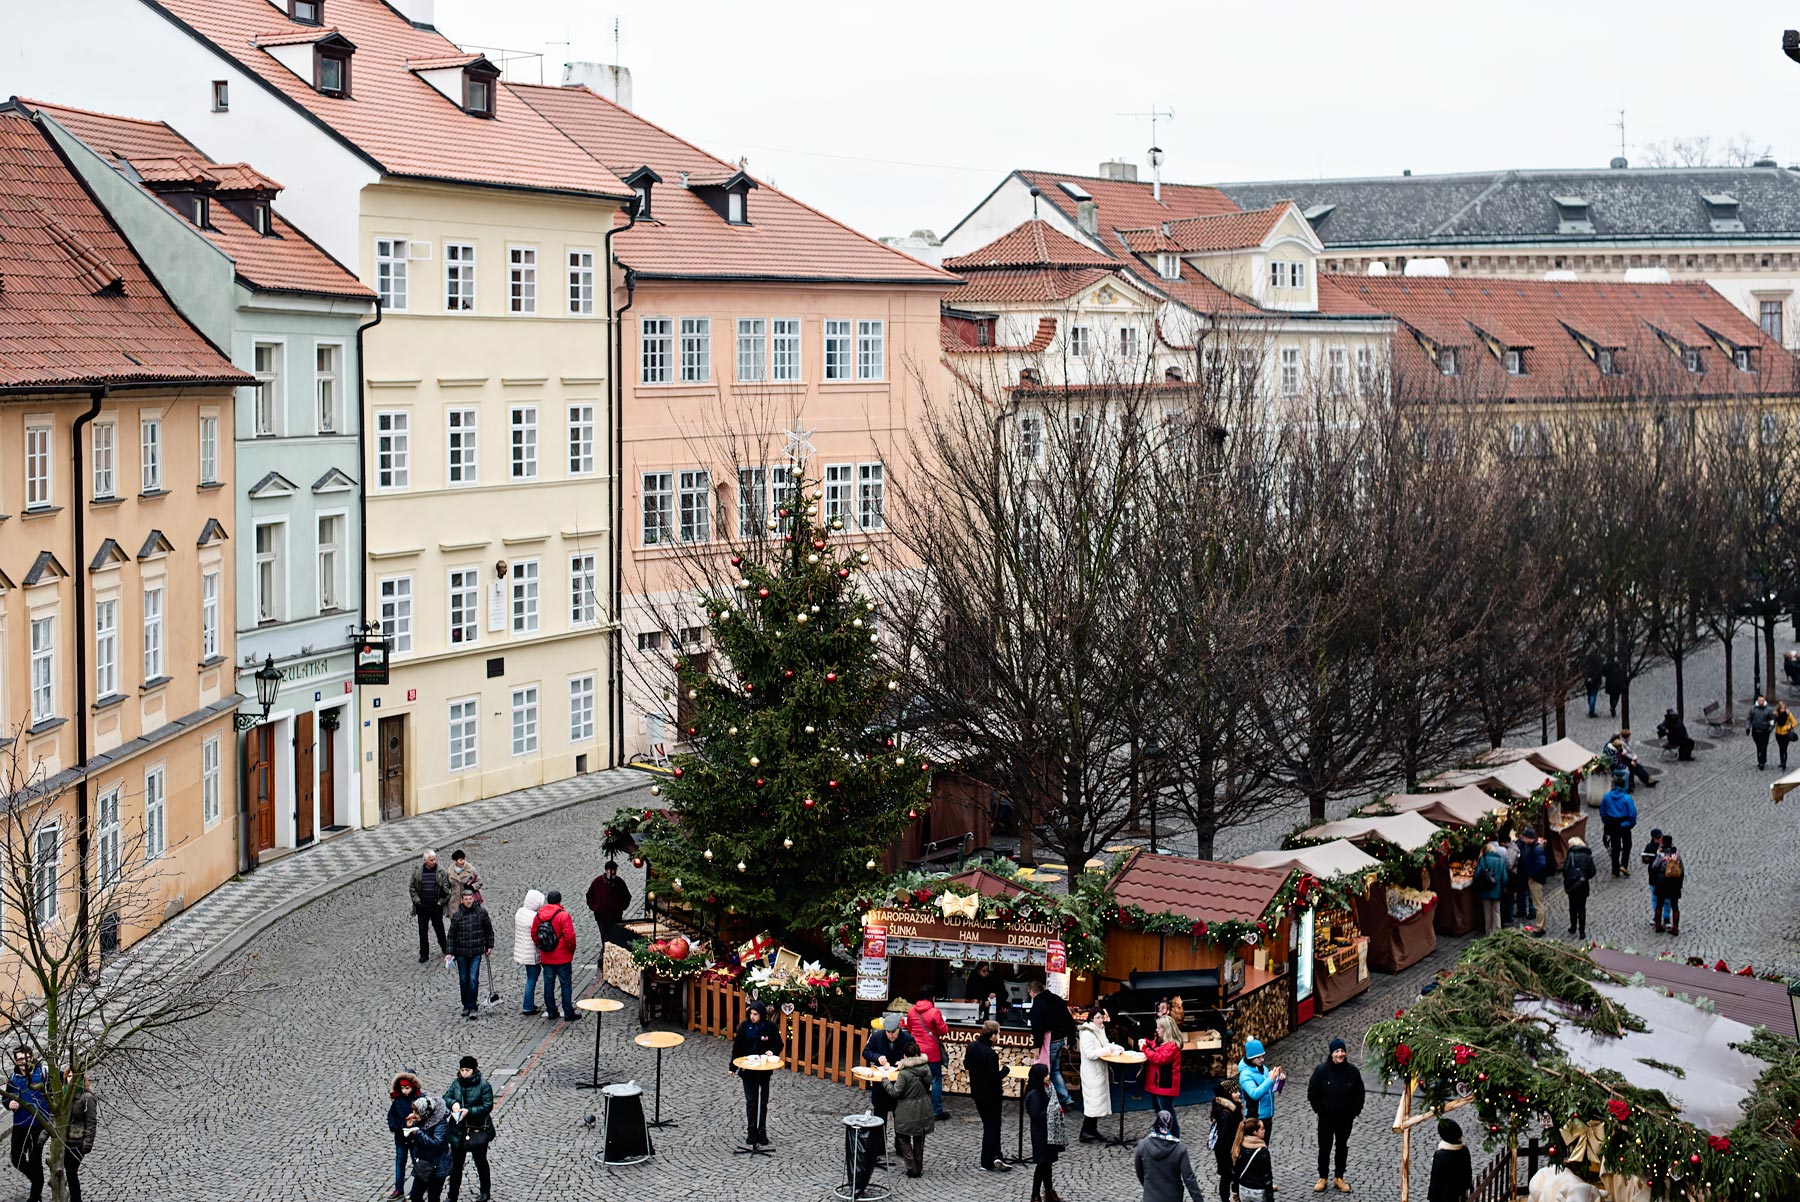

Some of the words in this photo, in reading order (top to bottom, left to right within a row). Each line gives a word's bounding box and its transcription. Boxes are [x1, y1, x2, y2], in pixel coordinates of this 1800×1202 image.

[889, 922, 917, 936] ŠUNKA
[943, 916, 961, 926] OLD
[962, 917, 997, 930] PRAGUE
[959, 930, 979, 941] HAM
[1007, 934, 1017, 945] DI
[1018, 935, 1047, 947] PRAGA
[997, 1034, 1035, 1047] HALUŠ
